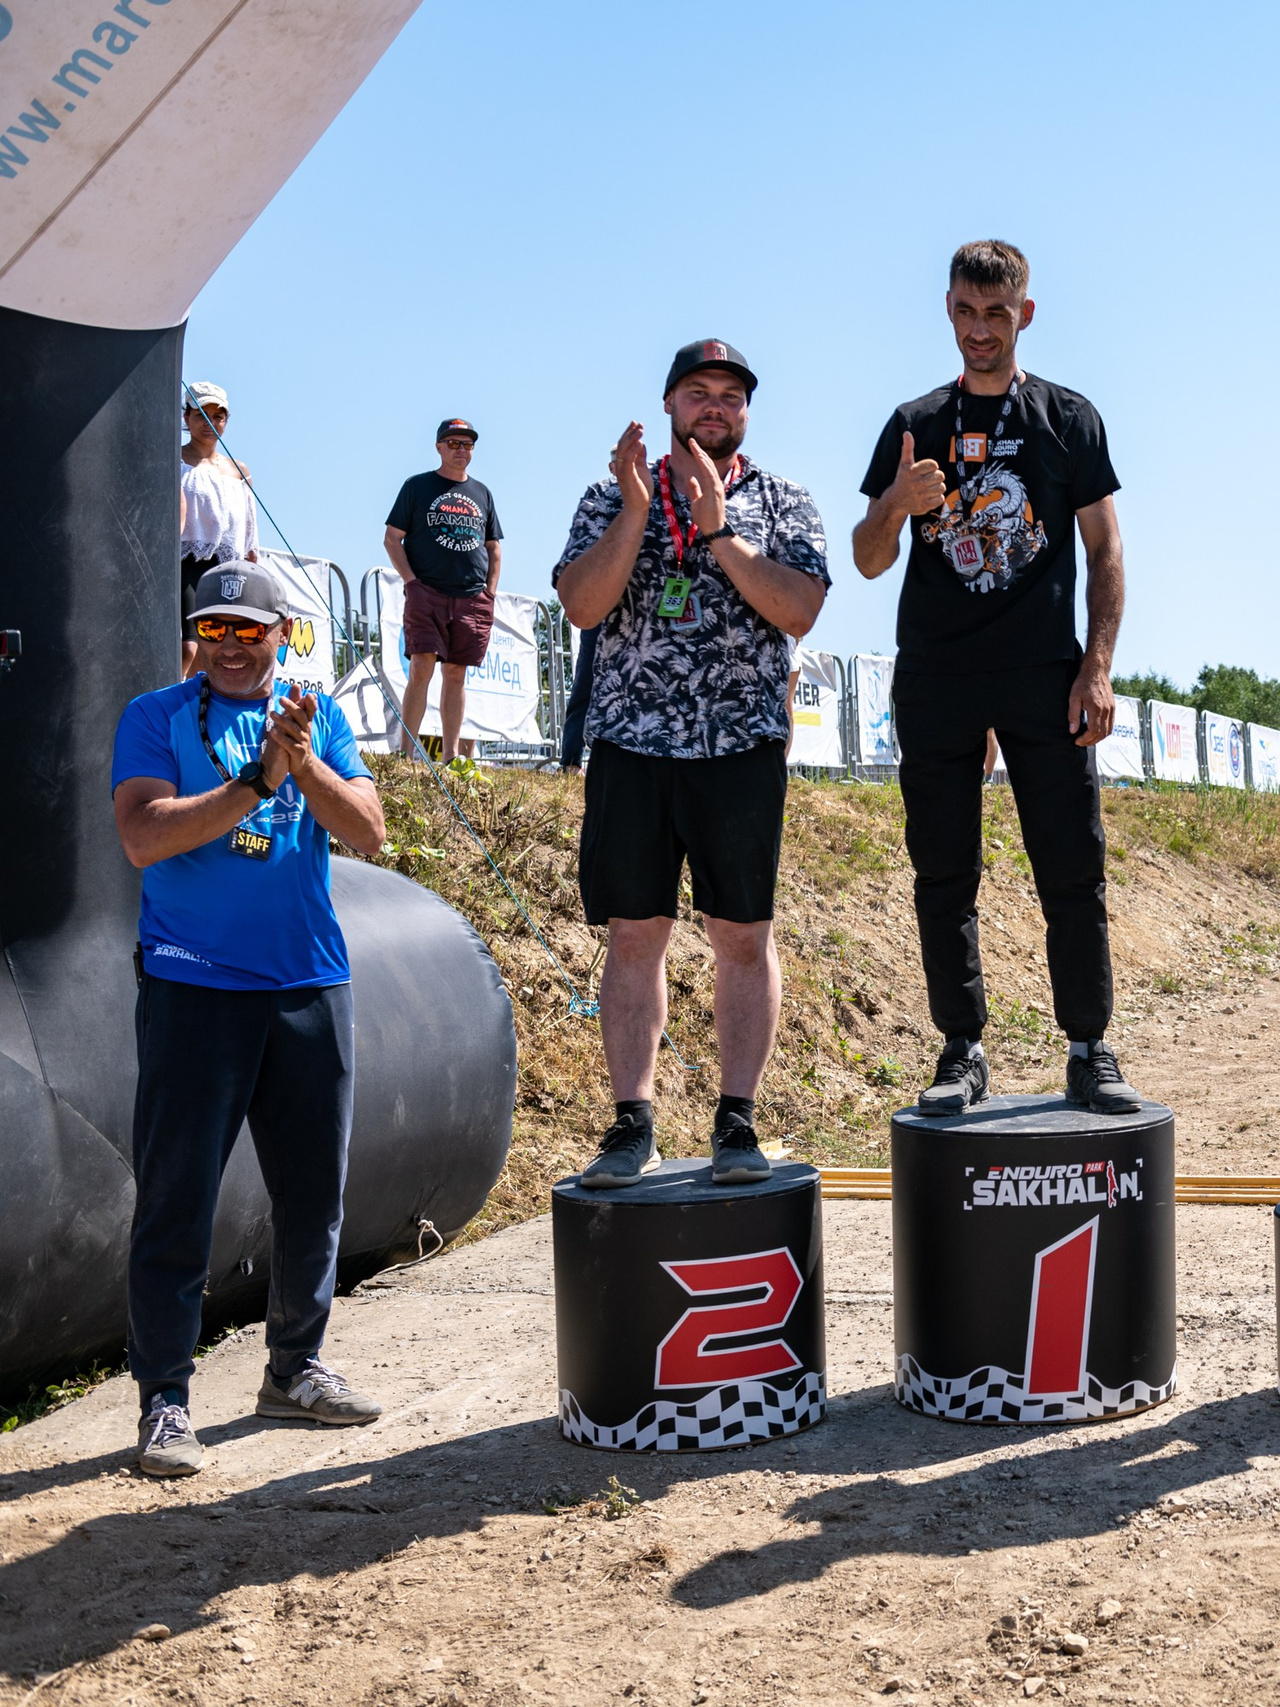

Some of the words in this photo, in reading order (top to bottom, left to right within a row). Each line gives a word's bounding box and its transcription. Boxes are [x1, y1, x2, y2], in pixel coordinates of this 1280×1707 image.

[426, 512, 486, 531] FAMILY
[435, 535, 480, 552] PARADISE
[257, 811, 301, 824] 2025
[237, 832, 271, 852] STAFF
[987, 1164, 1083, 1181] ENDURO
[1085, 1162, 1103, 1173] PARK
[654, 1246, 803, 1390] 2
[1022, 1214, 1101, 1396] 1
